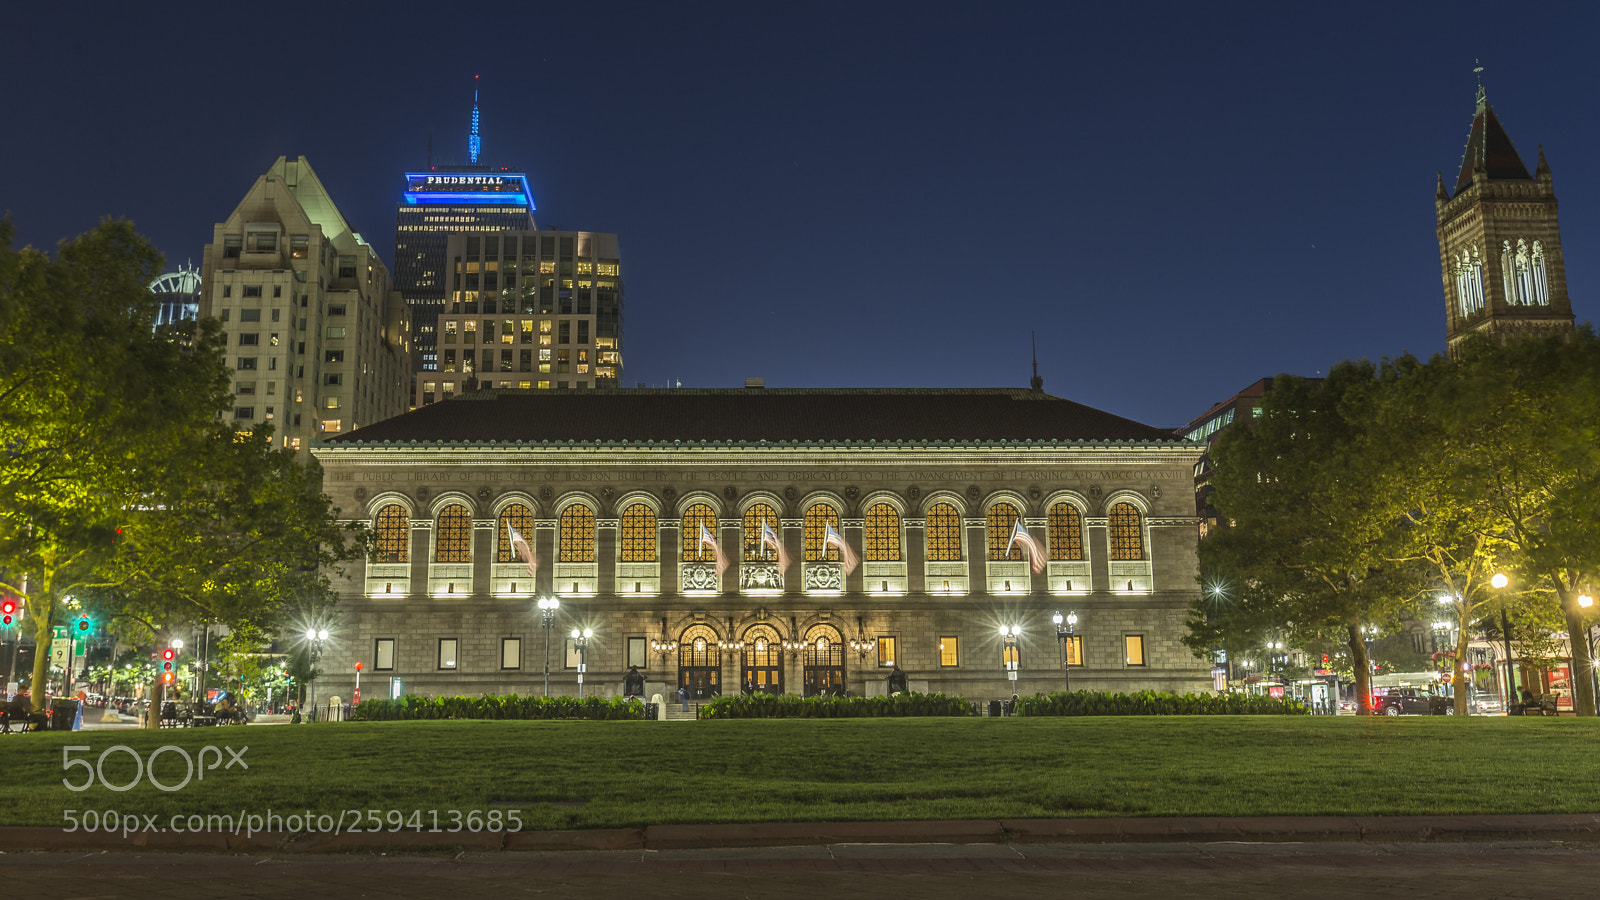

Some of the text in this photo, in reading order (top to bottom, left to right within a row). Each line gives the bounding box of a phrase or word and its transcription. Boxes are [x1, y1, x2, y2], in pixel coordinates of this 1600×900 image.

[427, 176, 503, 184] PRUDENTIAL
[362, 471, 398, 481] PUBLIC
[407, 471, 452, 481] LIBRARY
[458, 471, 473, 481] OF
[484, 471, 502, 481] THE
[509, 471, 536, 481] CITY
[544, 471, 558, 481] OF
[565, 471, 611, 481] BOSTON
[618, 471, 647, 481] BUILT
[655, 471, 670, 481] BY
[680, 471, 700, 481] THE
[708, 471, 747, 481] PEOPLE
[756, 471, 779, 481] AND
[788, 471, 849, 481] DEDICATED
[859, 471, 873, 481] TO
[880, 471, 900, 481] THE
[907, 471, 983, 481] ADVANCEMENT
[992, 471, 1007, 481] OF
[1014, 471, 1068, 481] LEARNING
[57, 650, 63, 658] 9
